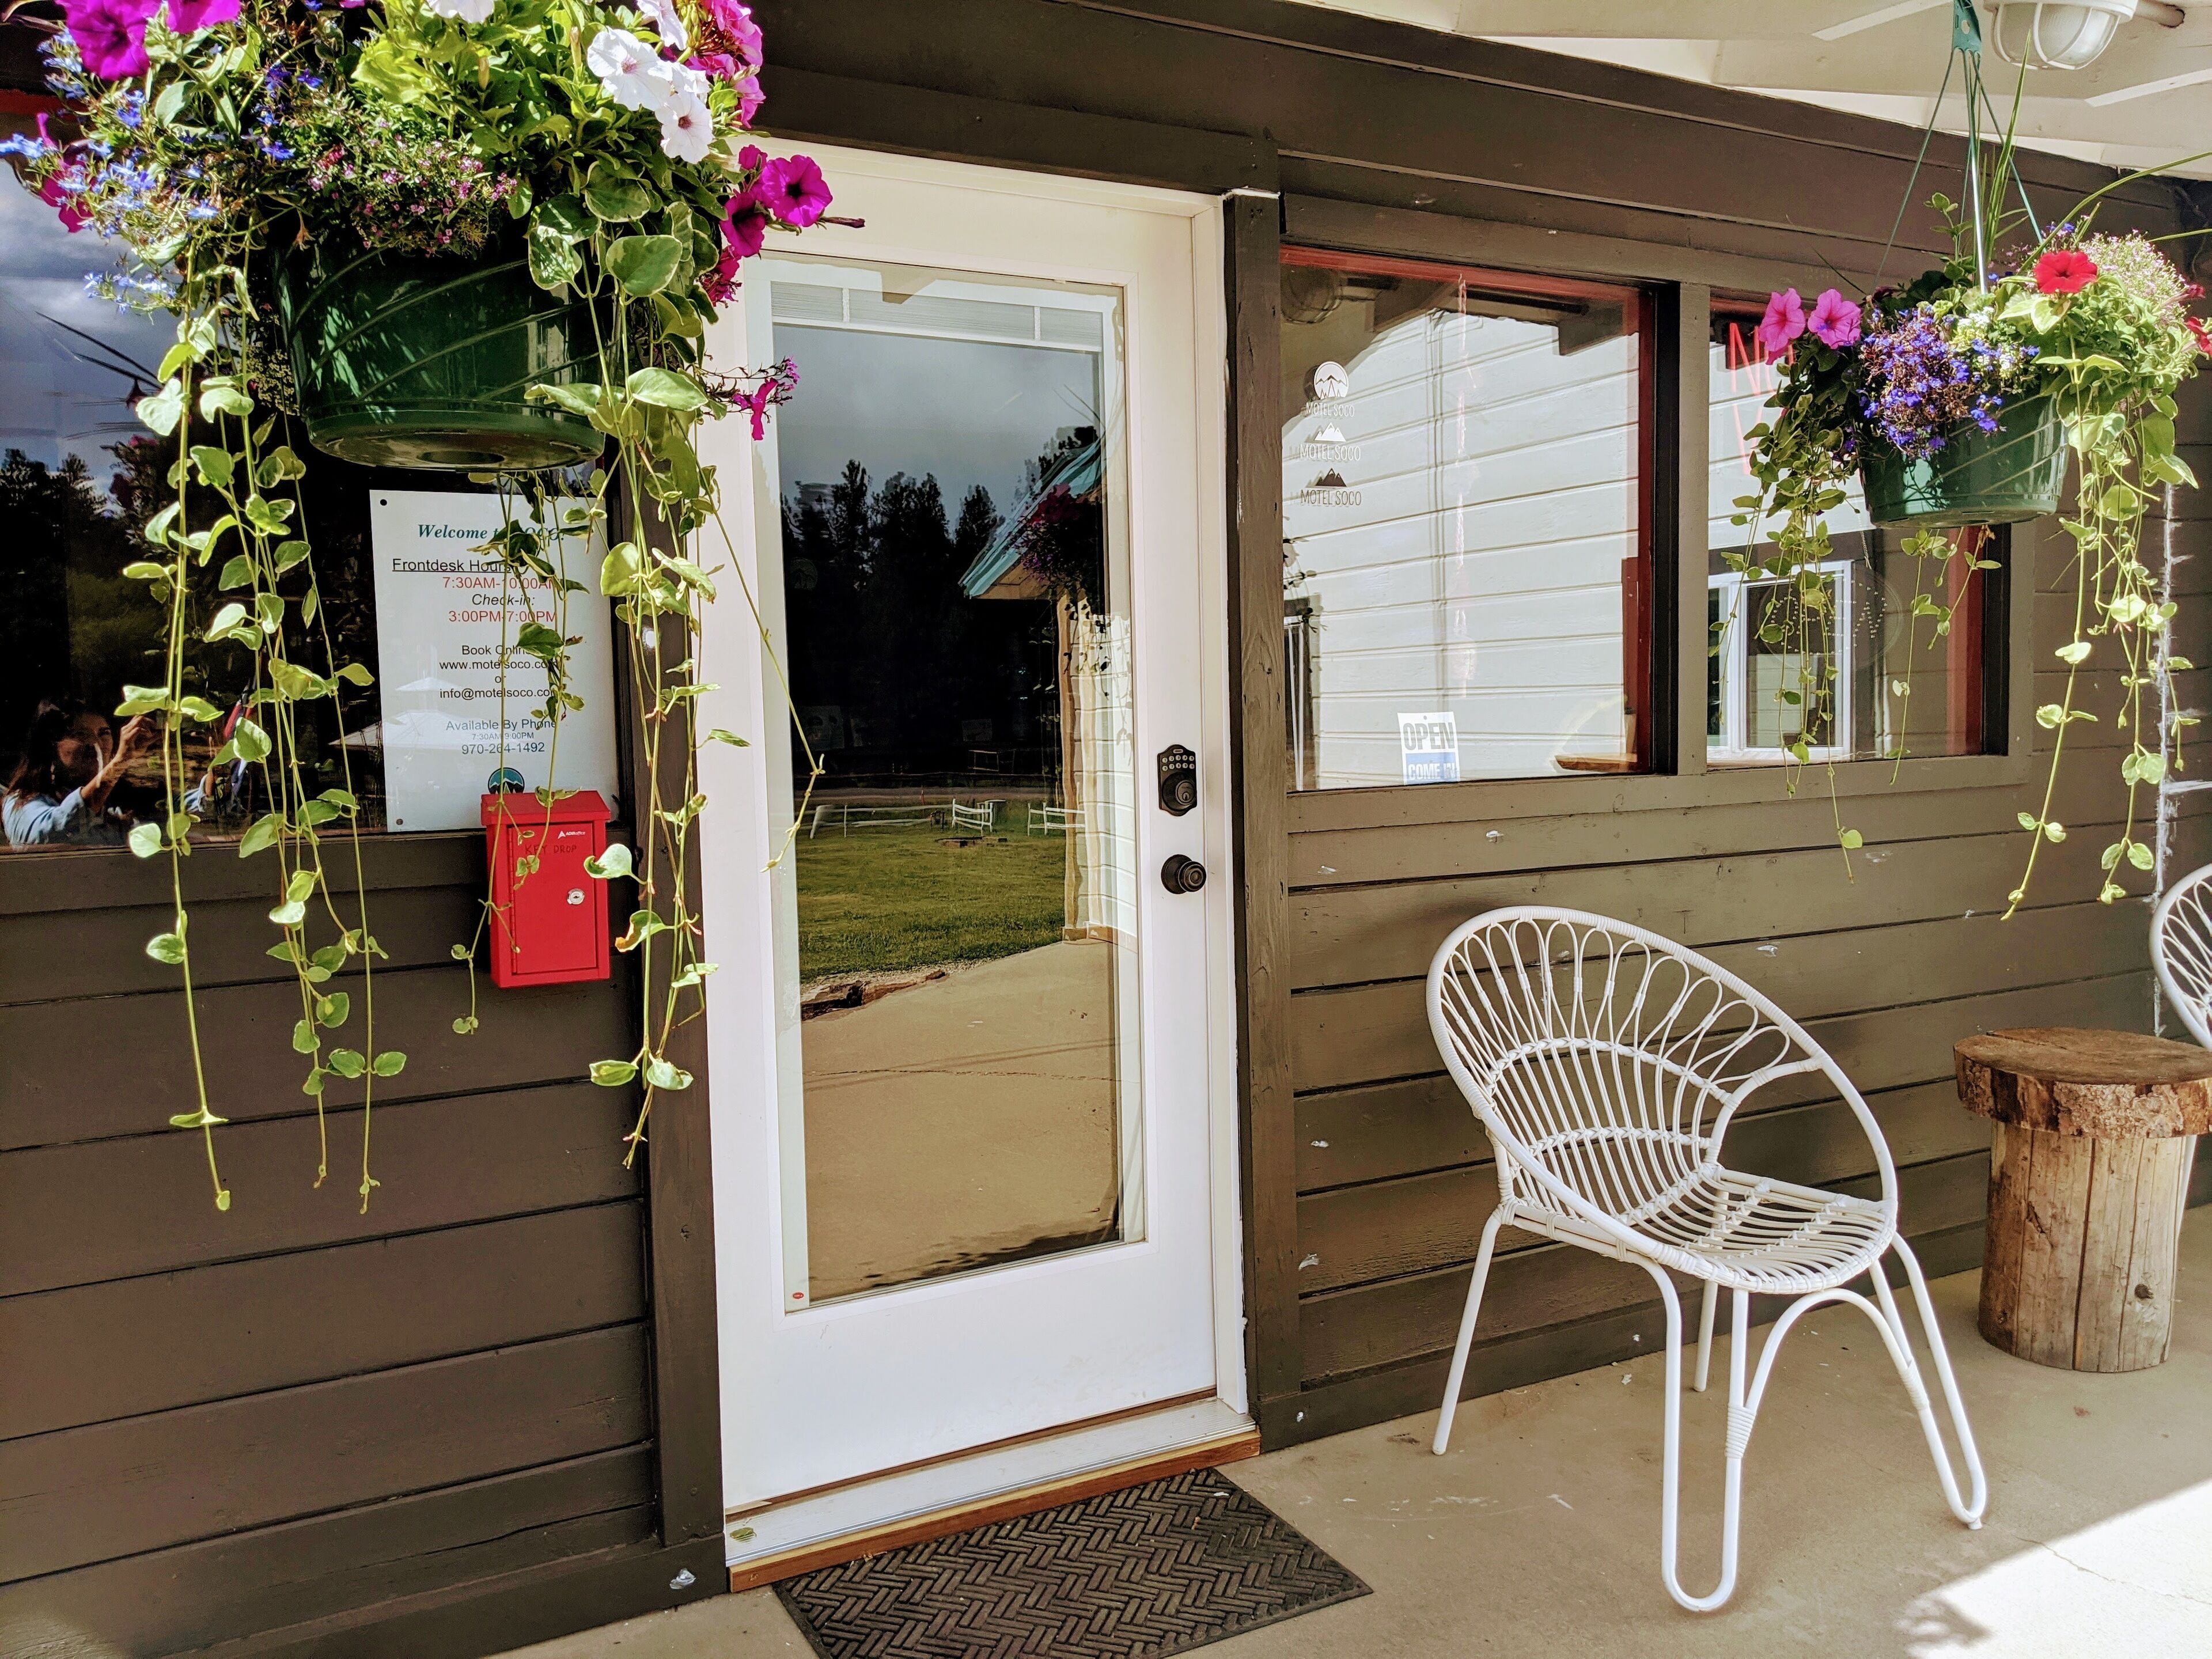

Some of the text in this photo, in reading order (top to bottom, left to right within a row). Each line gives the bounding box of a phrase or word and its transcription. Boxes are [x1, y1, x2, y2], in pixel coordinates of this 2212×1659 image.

[1306, 402, 1355, 418] MOTEL SOCO
[1300, 444, 1361, 461] MOTEL SOCO
[1301, 489, 1362, 506] MOTEL SOCO
[418, 524, 487, 539] Welcome
[393, 558, 464, 572] Frontdesk
[462, 645, 492, 655] Book
[446, 719, 499, 730] Available
[503, 719, 518, 732] By
[1403, 722, 1455, 751] OPEN
[1408, 763, 1441, 780] COME
[525, 843, 577, 855] KEY DROP
